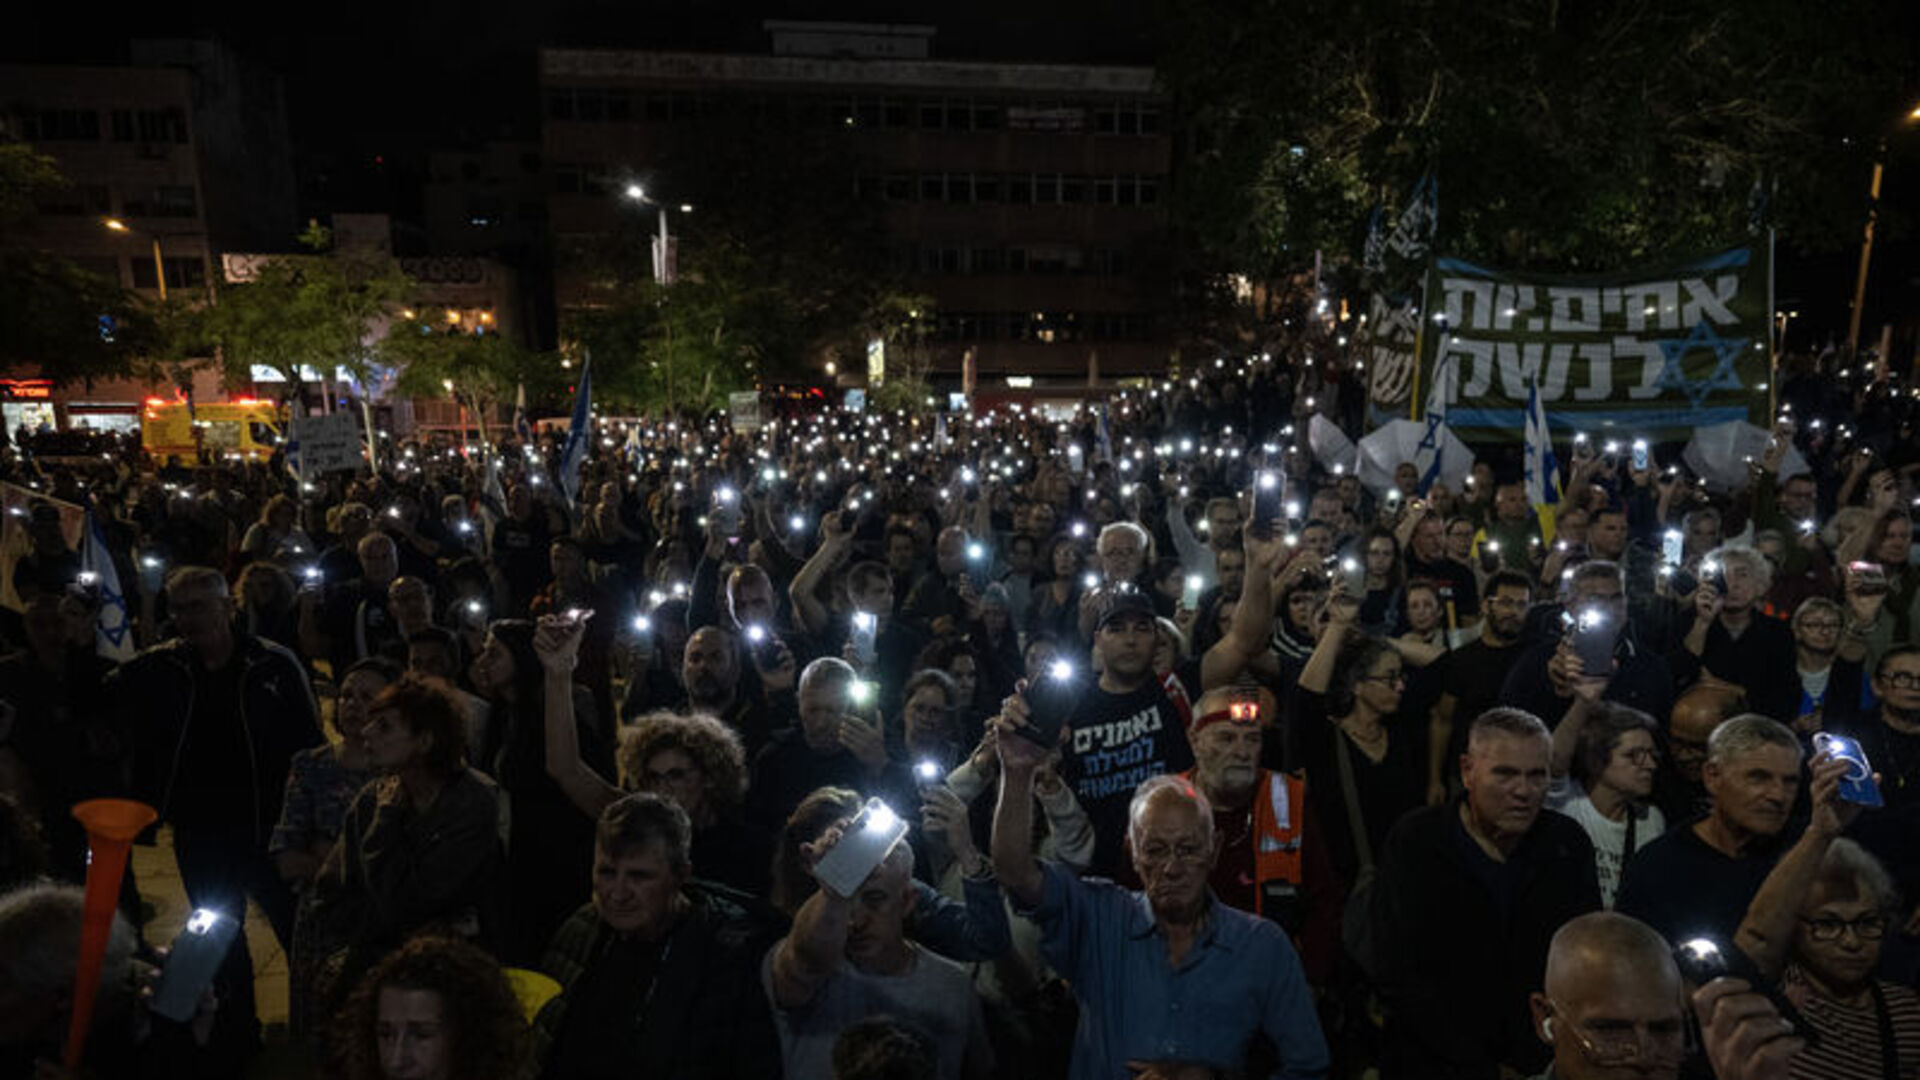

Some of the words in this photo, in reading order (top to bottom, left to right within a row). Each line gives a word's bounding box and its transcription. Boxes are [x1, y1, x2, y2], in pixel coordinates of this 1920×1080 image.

[1442, 275, 1741, 331] אחים.יות
[1446, 335, 1667, 404] לנשק
[1074, 705, 1163, 754] נאמנים
